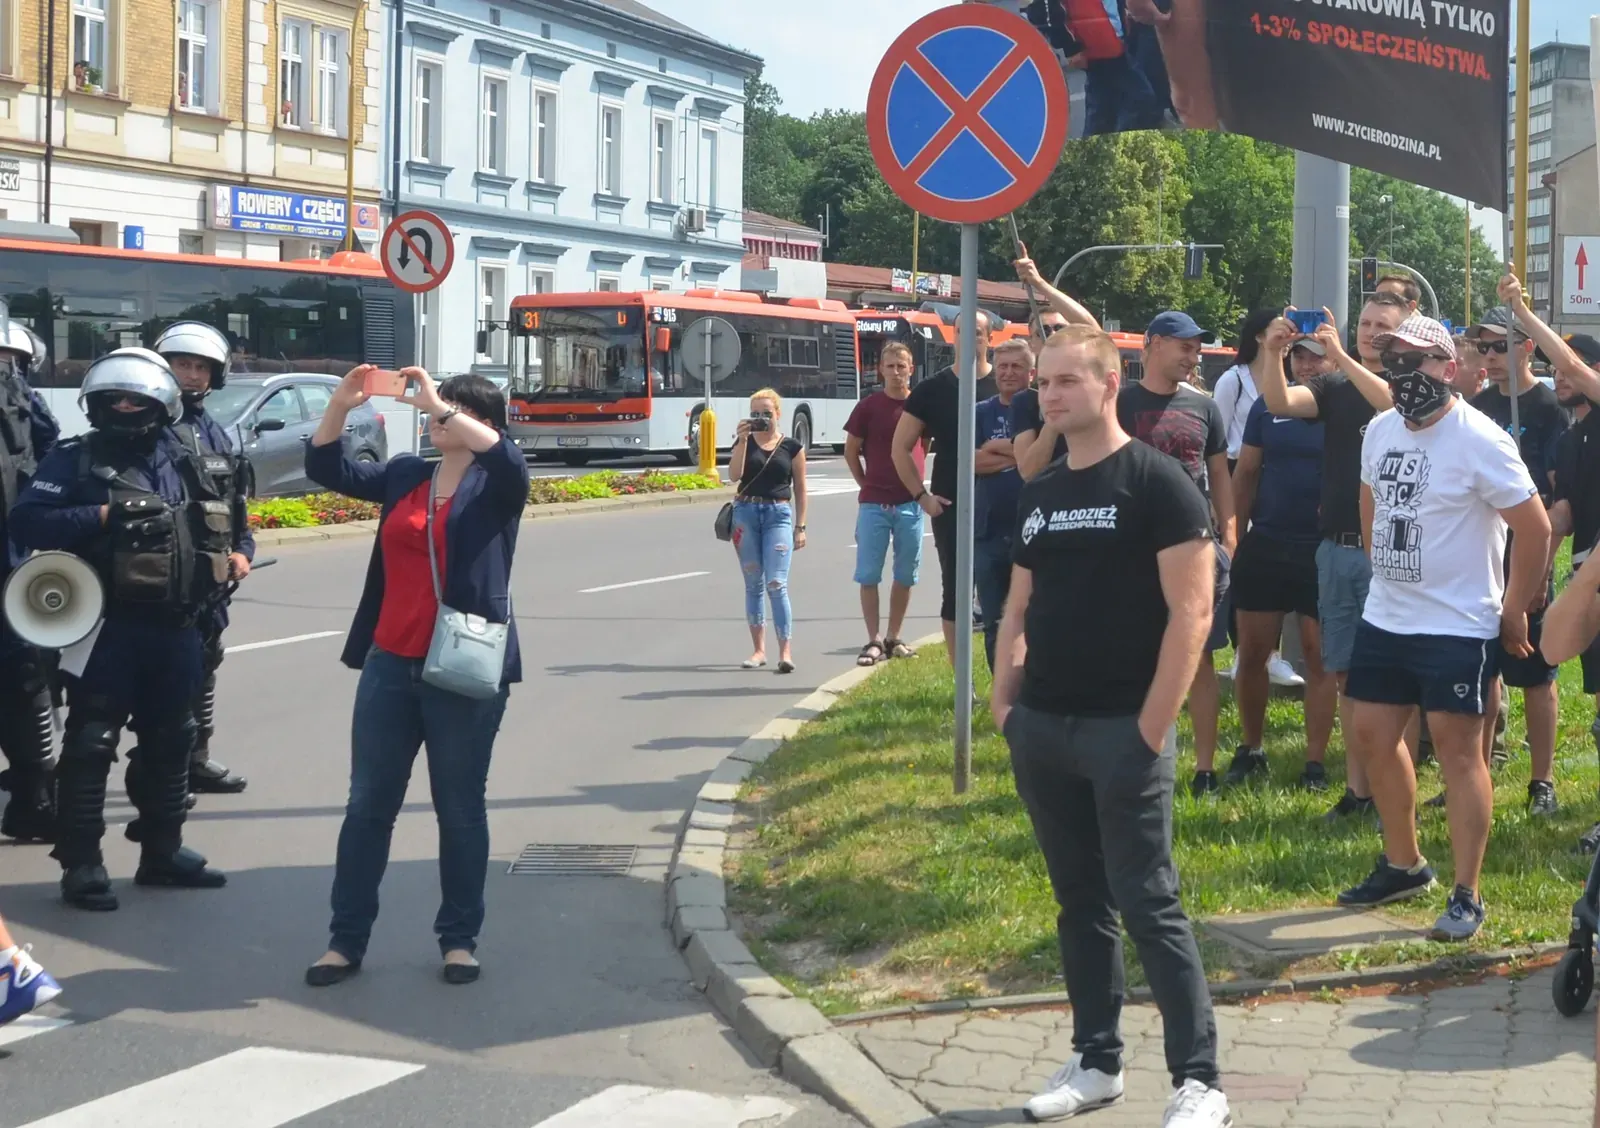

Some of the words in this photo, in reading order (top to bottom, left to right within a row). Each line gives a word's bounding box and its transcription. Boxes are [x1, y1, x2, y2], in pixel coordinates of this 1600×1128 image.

[1309, 0, 1427, 28] OWIĄ
[1431, 1, 1496, 37] TYLKO
[1250, 12, 1302, 41] 1-3%
[1307, 20, 1492, 81] SPOŁECZEŃSTWA.
[1311, 112, 1442, 161] WWW.ZYCIERODZINA.PL
[237, 191, 292, 217] ROWERY
[302, 199, 345, 223] CZĘŚCI
[1569, 294, 1592, 304] 50m
[524, 311, 540, 329] 31
[663, 308, 677, 322] 915
[856, 320, 881, 332] Główny
[883, 320, 897, 331] PKP
[1381, 457, 1402, 475] NY
[1404, 458, 1417, 476] S
[31, 480, 62, 494] POLICJA
[1386, 484, 1395, 501] F
[1397, 484, 1408, 503] C
[1049, 504, 1118, 523] MŁODZIEŻ
[1048, 520, 1116, 531] WSZECHPOLSKA
[1371, 545, 1421, 571] eekend
[1384, 566, 1421, 583] comes
